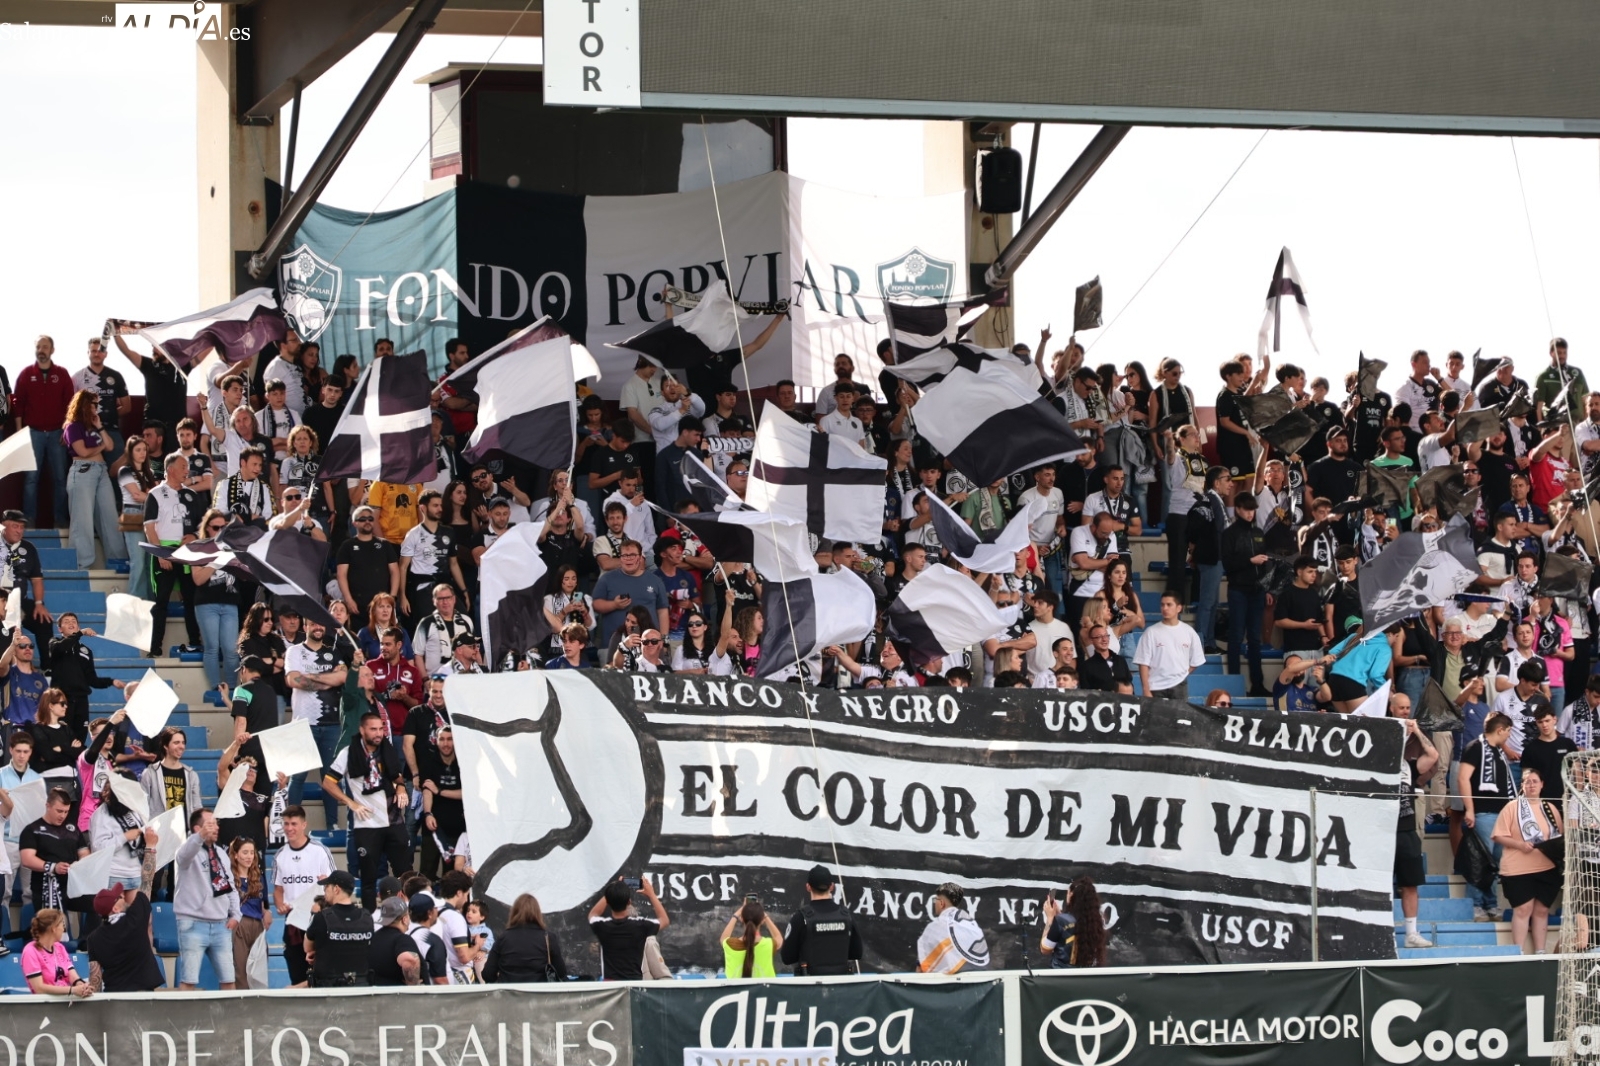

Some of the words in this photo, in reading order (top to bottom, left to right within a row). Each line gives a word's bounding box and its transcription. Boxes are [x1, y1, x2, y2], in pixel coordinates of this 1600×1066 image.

[354, 262, 572, 331] FONDO
[630, 675, 783, 709] BLANCO
[799, 691, 821, 714] Y
[841, 692, 961, 724] NEGRO
[1042, 700, 1141, 734] USCF
[1223, 714, 1374, 759] BLANCO
[679, 764, 758, 817] EL
[782, 766, 979, 839] COLOR
[1004, 788, 1082, 842] DE
[1106, 794, 1186, 850] MI
[1212, 802, 1357, 869] VIDA
[282, 875, 314, 884] adidas
[643, 872, 739, 902] USCF
[998, 897, 1120, 930] NEO
[1201, 912, 1294, 949] USCF
[816, 922, 845, 932] SEGURIDAD
[329, 931, 372, 941] SEGURIDAD
[142, 1030, 215, 1066] DE
[378, 1019, 618, 1066] FRAILES
[1149, 1018, 1251, 1045] HACHA
[1258, 1014, 1361, 1042] MOTOR
